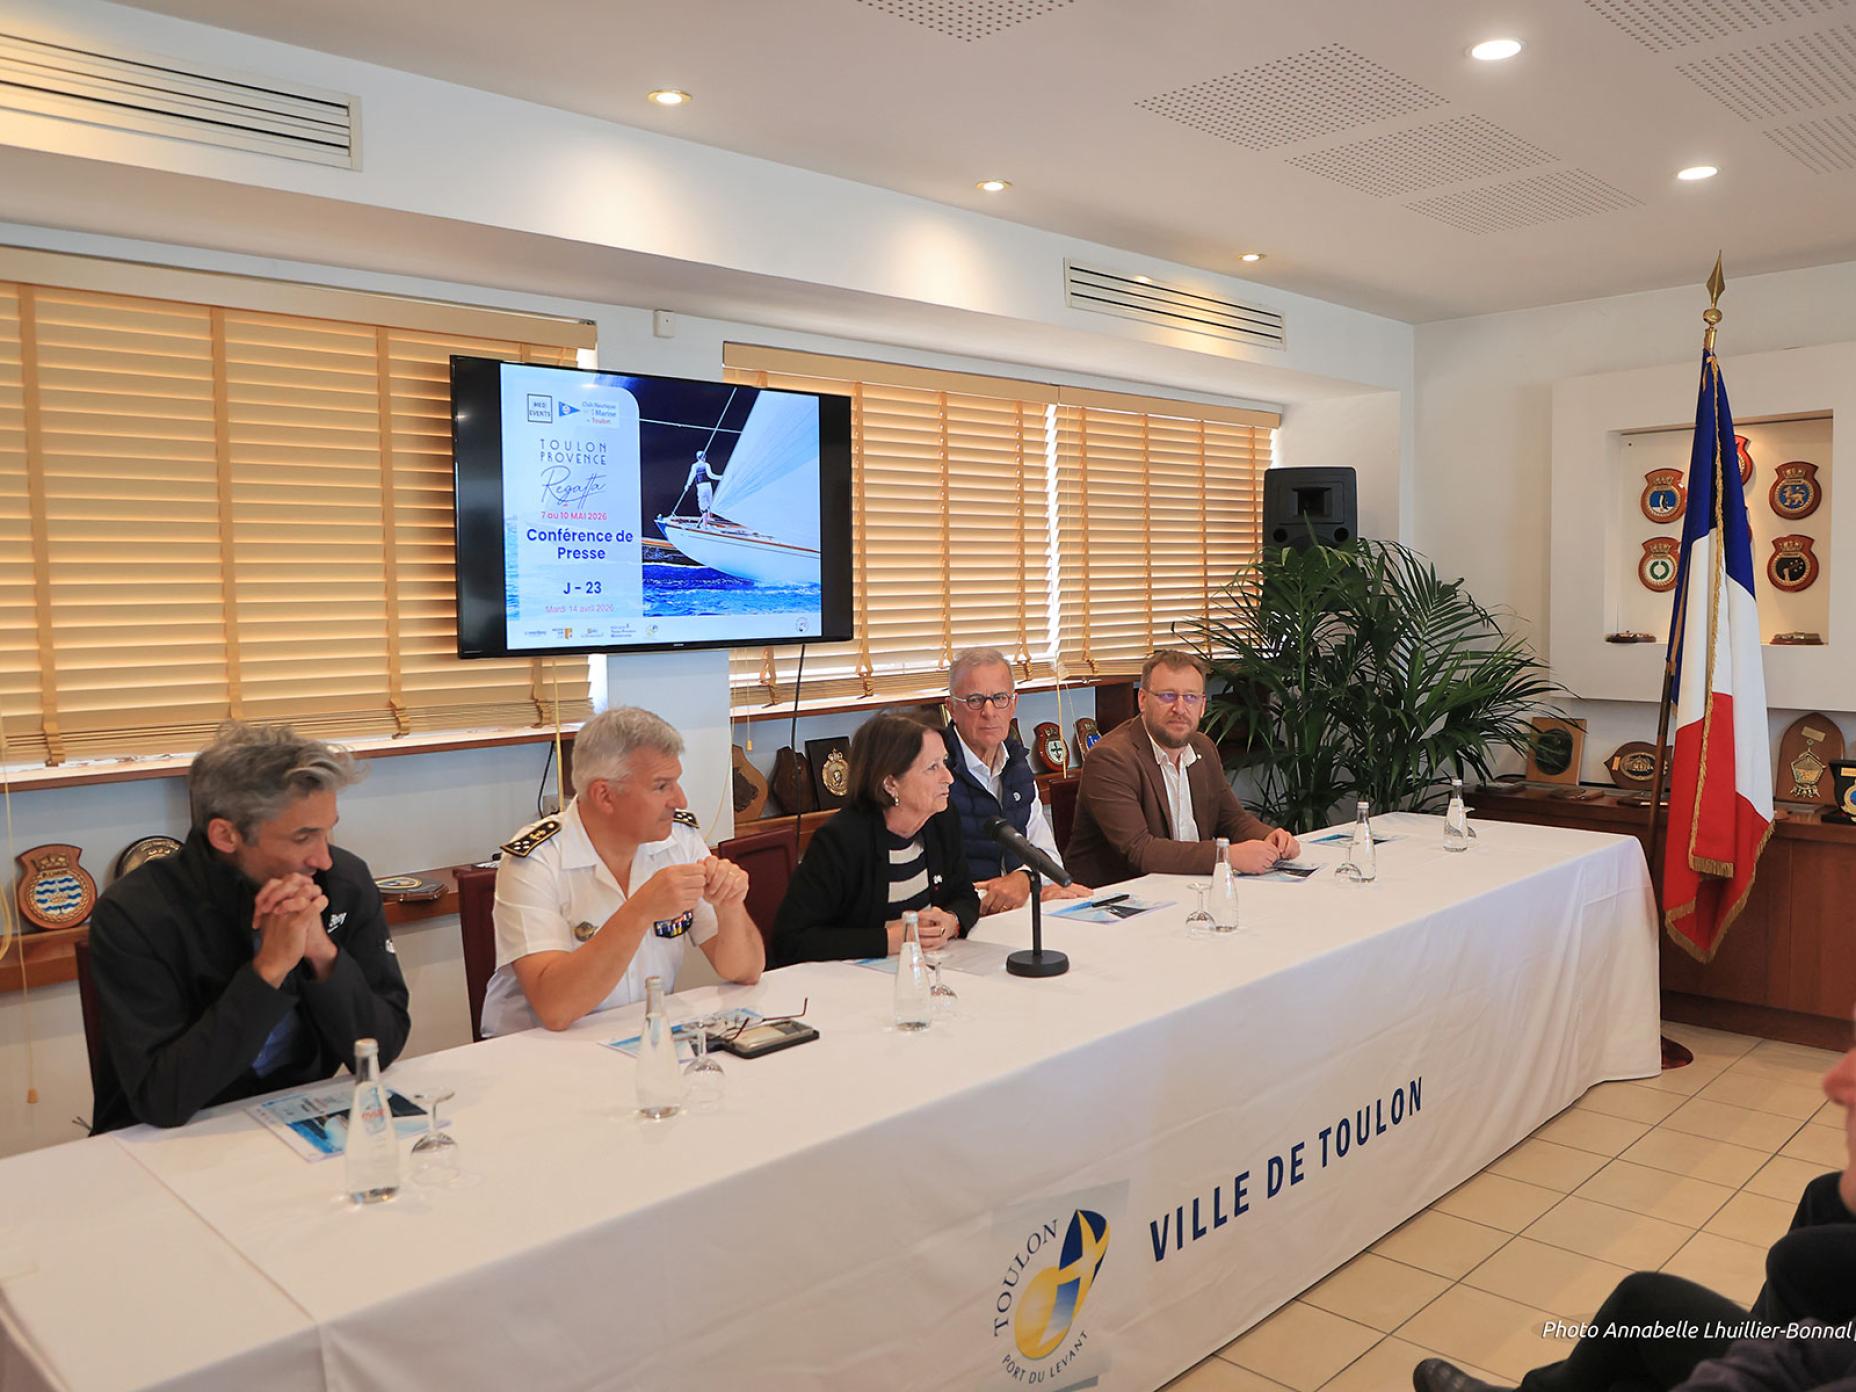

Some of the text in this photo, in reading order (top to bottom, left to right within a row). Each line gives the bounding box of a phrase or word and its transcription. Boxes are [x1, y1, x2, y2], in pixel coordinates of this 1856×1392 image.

[540, 438, 607, 453] TOULON
[540, 451, 607, 465] PROVENCE
[540, 464, 608, 510] Regatta
[541, 511, 608, 521] 7 au 10 MAI 2026
[526, 528, 634, 543] Conférence de
[557, 546, 606, 560] Presse
[563, 582, 571, 595] J
[585, 581, 602, 595] 23
[1149, 1076, 1423, 1263] VILLE DE TOULON
[993, 1218, 1058, 1337] TOULON
[1002, 1329, 1088, 1385] PORT DU LEVANT
